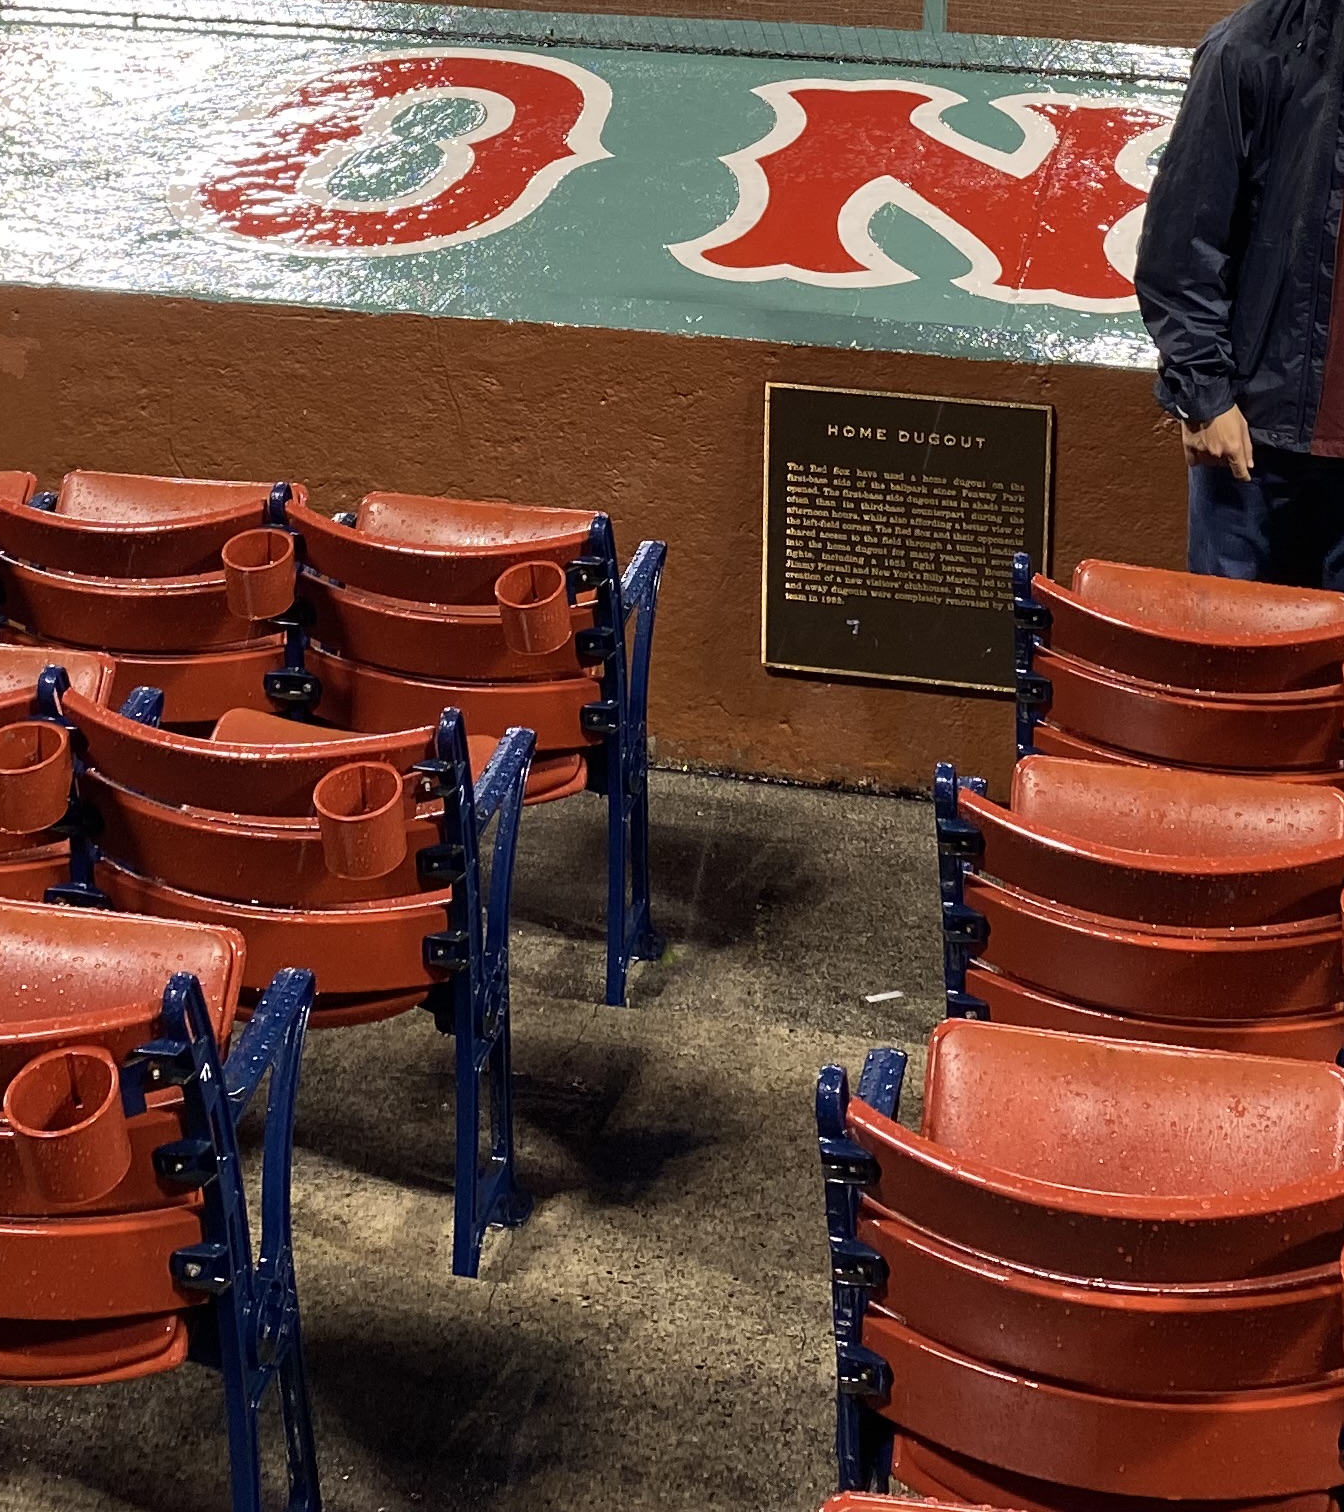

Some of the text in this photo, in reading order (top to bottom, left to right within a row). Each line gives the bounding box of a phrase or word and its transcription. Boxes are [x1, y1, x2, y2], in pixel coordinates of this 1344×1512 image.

[827, 423, 987, 450] HOME DUGOUT
[786, 461, 805, 472] The
[856, 468, 878, 478] have
[922, 474, 948, 485] home
[952, 477, 987, 488] dugout
[1009, 482, 1026, 492] the
